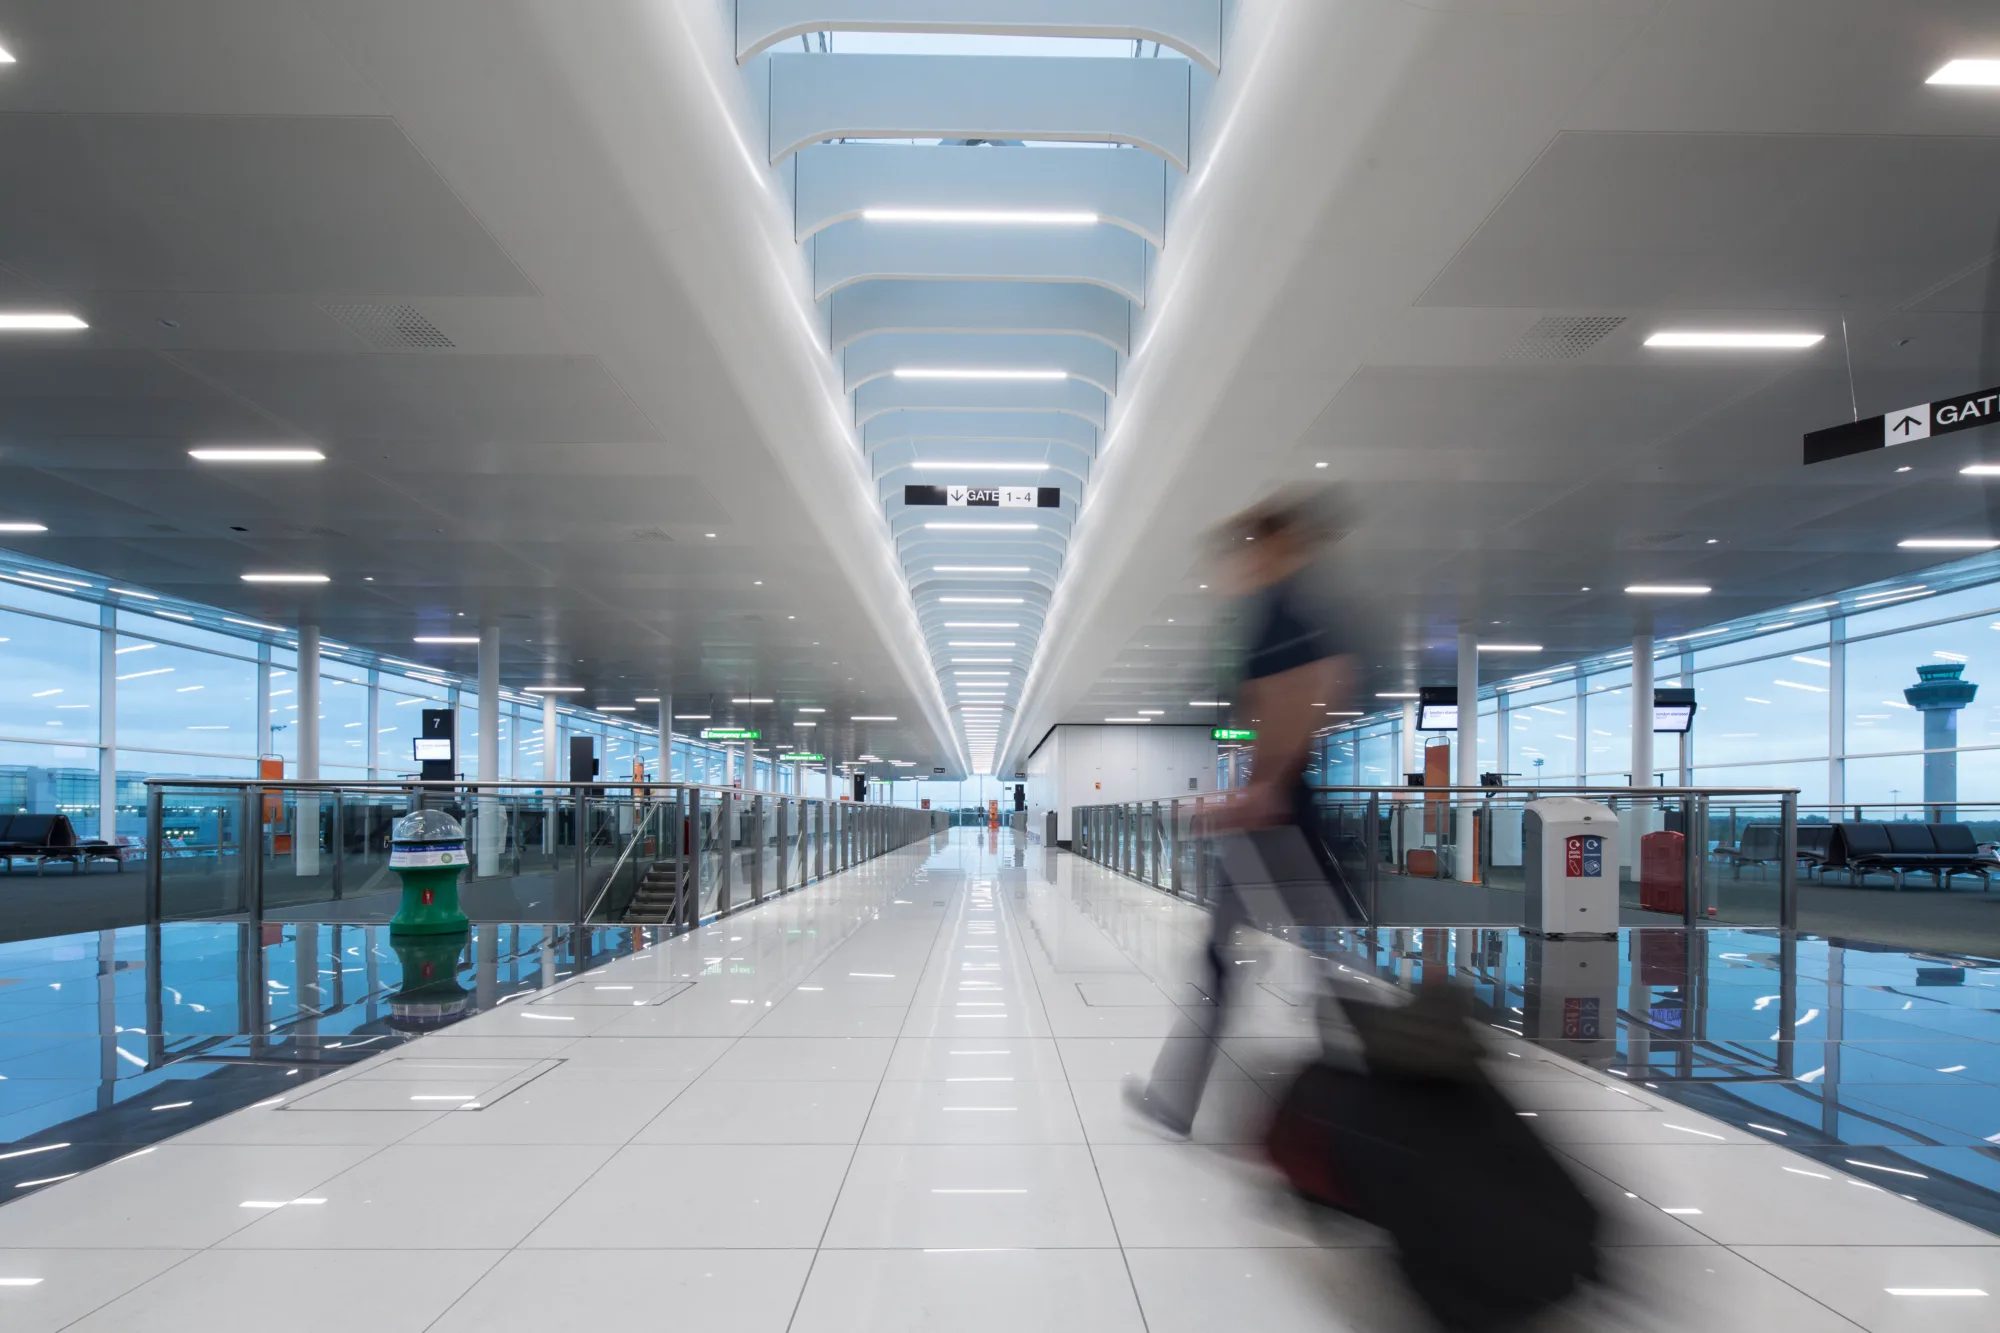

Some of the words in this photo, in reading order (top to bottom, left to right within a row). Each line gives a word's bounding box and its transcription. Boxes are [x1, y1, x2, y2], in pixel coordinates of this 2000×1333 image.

[1936, 394, 2000, 425] GAT
[967, 489, 999, 501] GATE
[433, 718, 441, 729] 7
[708, 731, 740, 739] Emergency
[741, 731, 752, 739] exit
